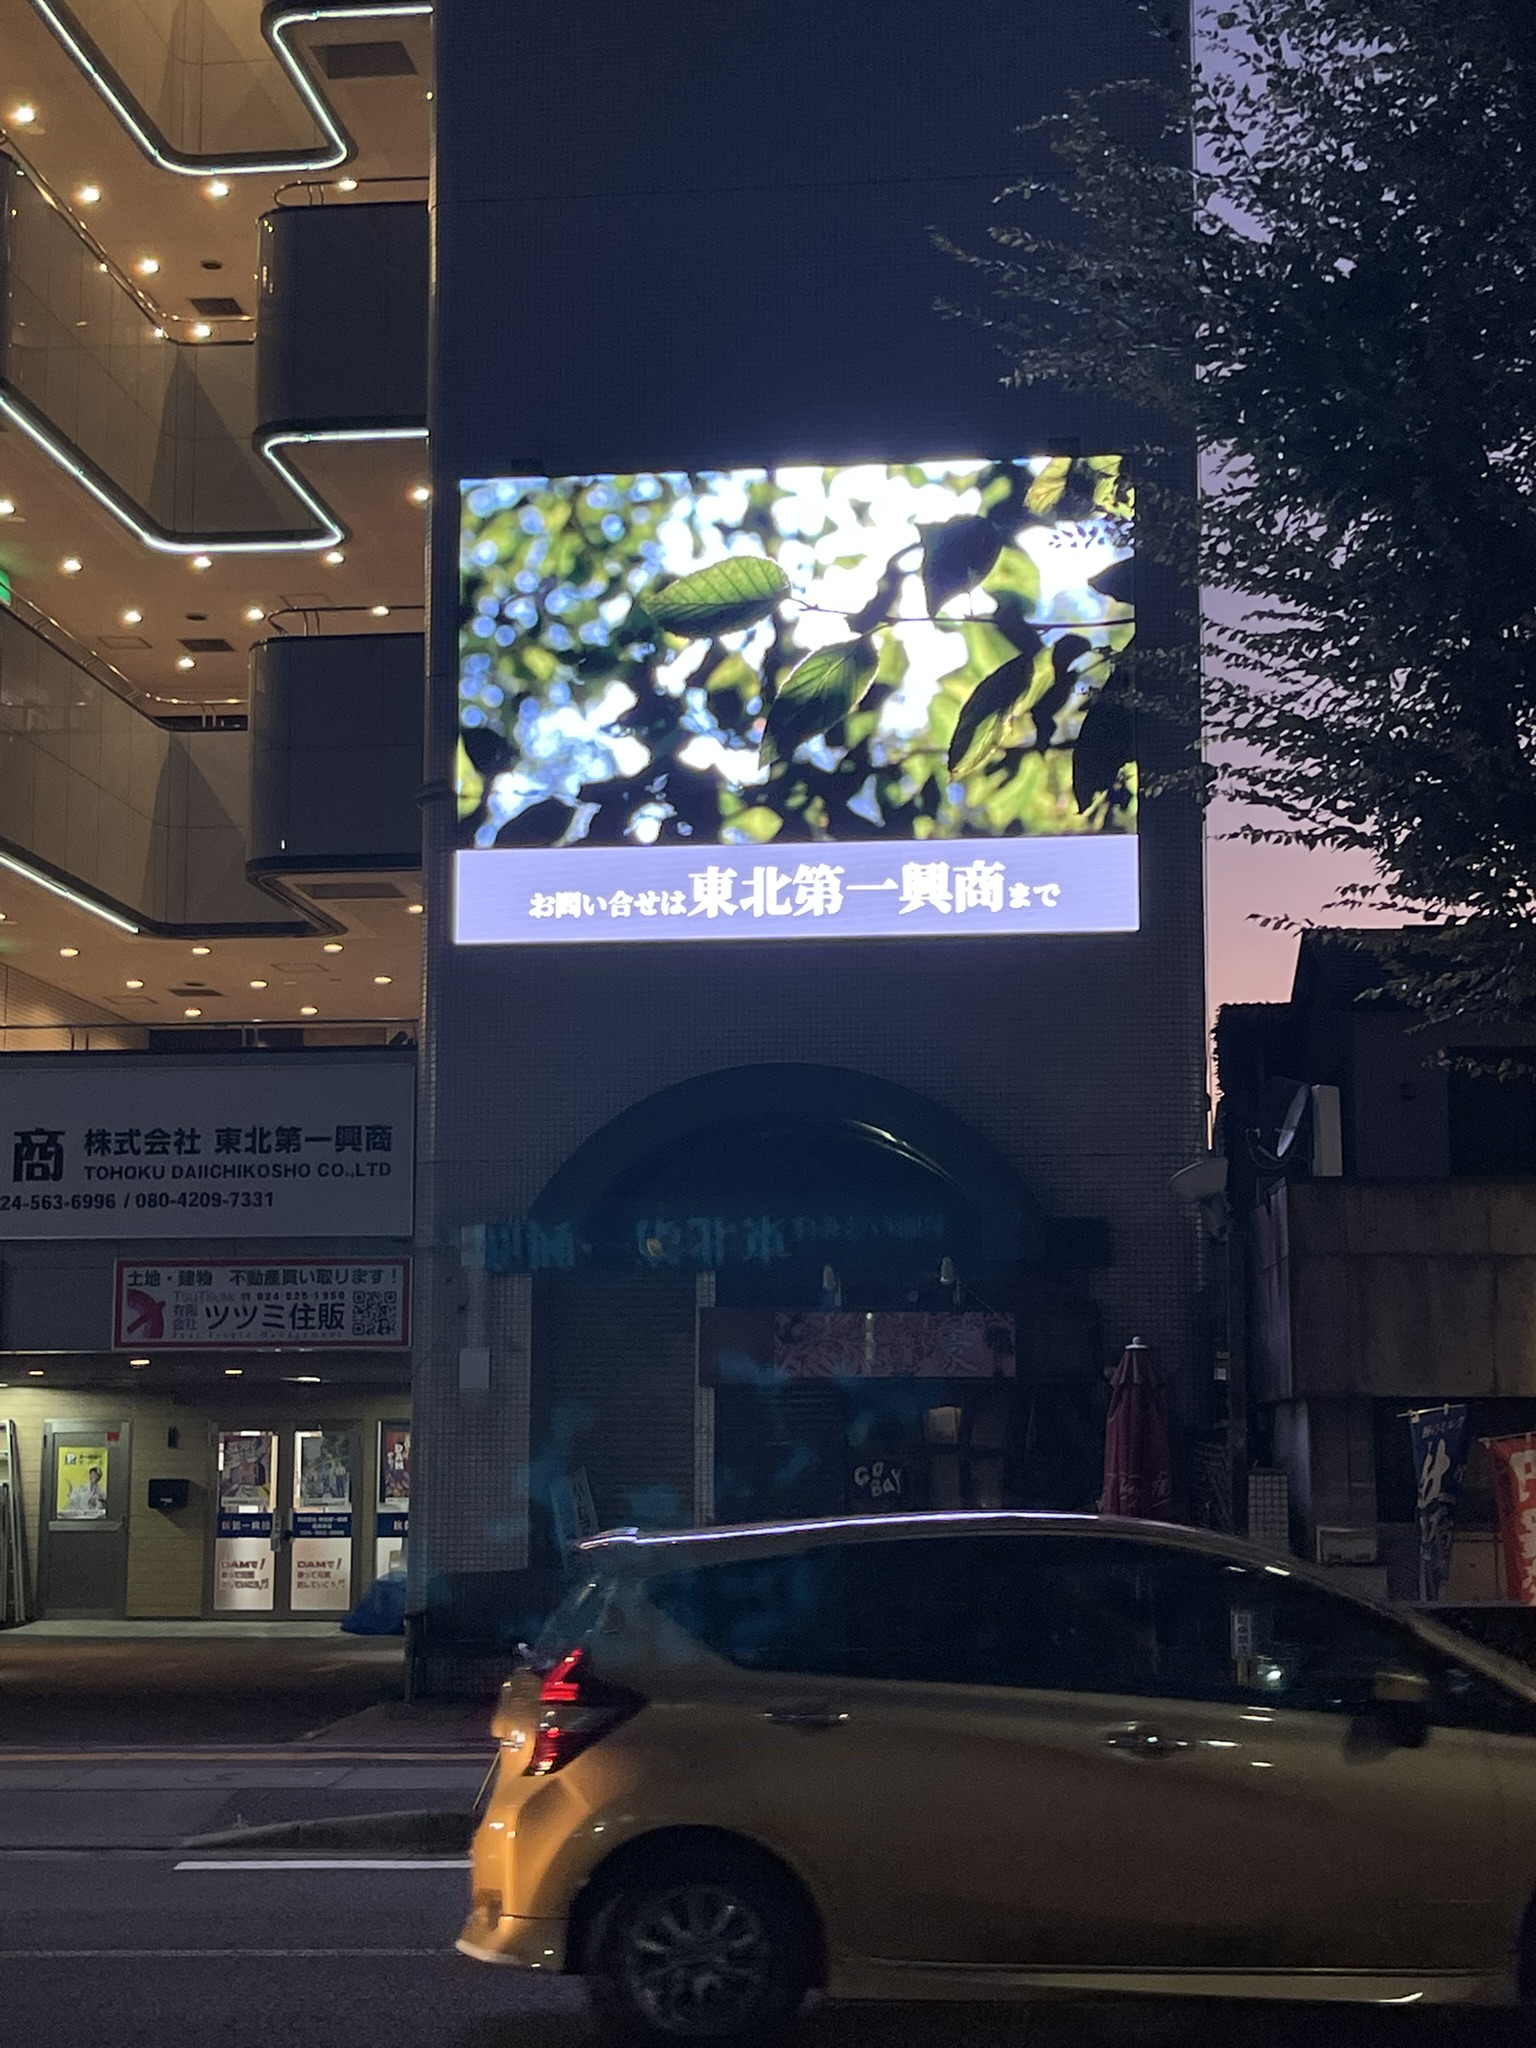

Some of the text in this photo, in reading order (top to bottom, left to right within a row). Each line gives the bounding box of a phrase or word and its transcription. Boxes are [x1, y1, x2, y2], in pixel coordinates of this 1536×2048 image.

[13, 1127, 66, 1182] 商
[84, 1124, 394, 1157] 株式会社 東北第一興商
[83, 1164, 165, 1180] TOHOKU
[172, 1163, 310, 1179] DAIICHIKOSHO
[136, 1191, 274, 1209] 080-4209-7331
[205, 1302, 345, 1330] ツツミ住販
